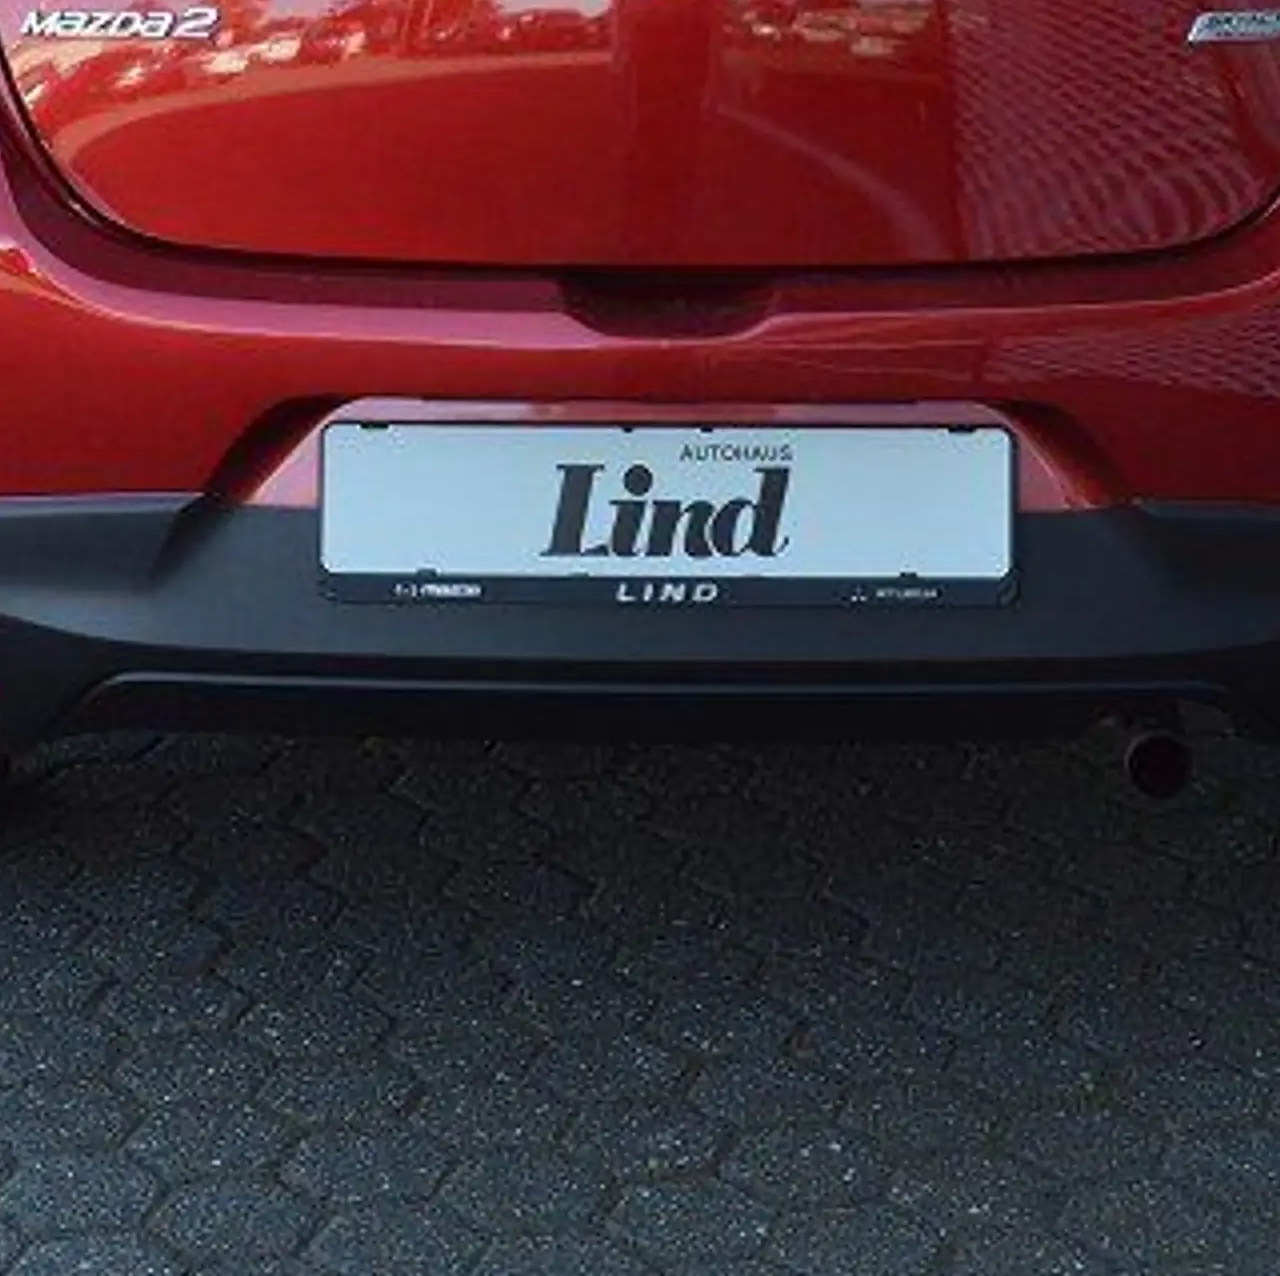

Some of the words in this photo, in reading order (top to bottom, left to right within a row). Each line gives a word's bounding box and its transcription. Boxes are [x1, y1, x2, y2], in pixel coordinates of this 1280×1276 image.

[679, 443, 794, 462] AUTOHAUS
[539, 463, 792, 559] Lind
[615, 582, 719, 602] LIND
